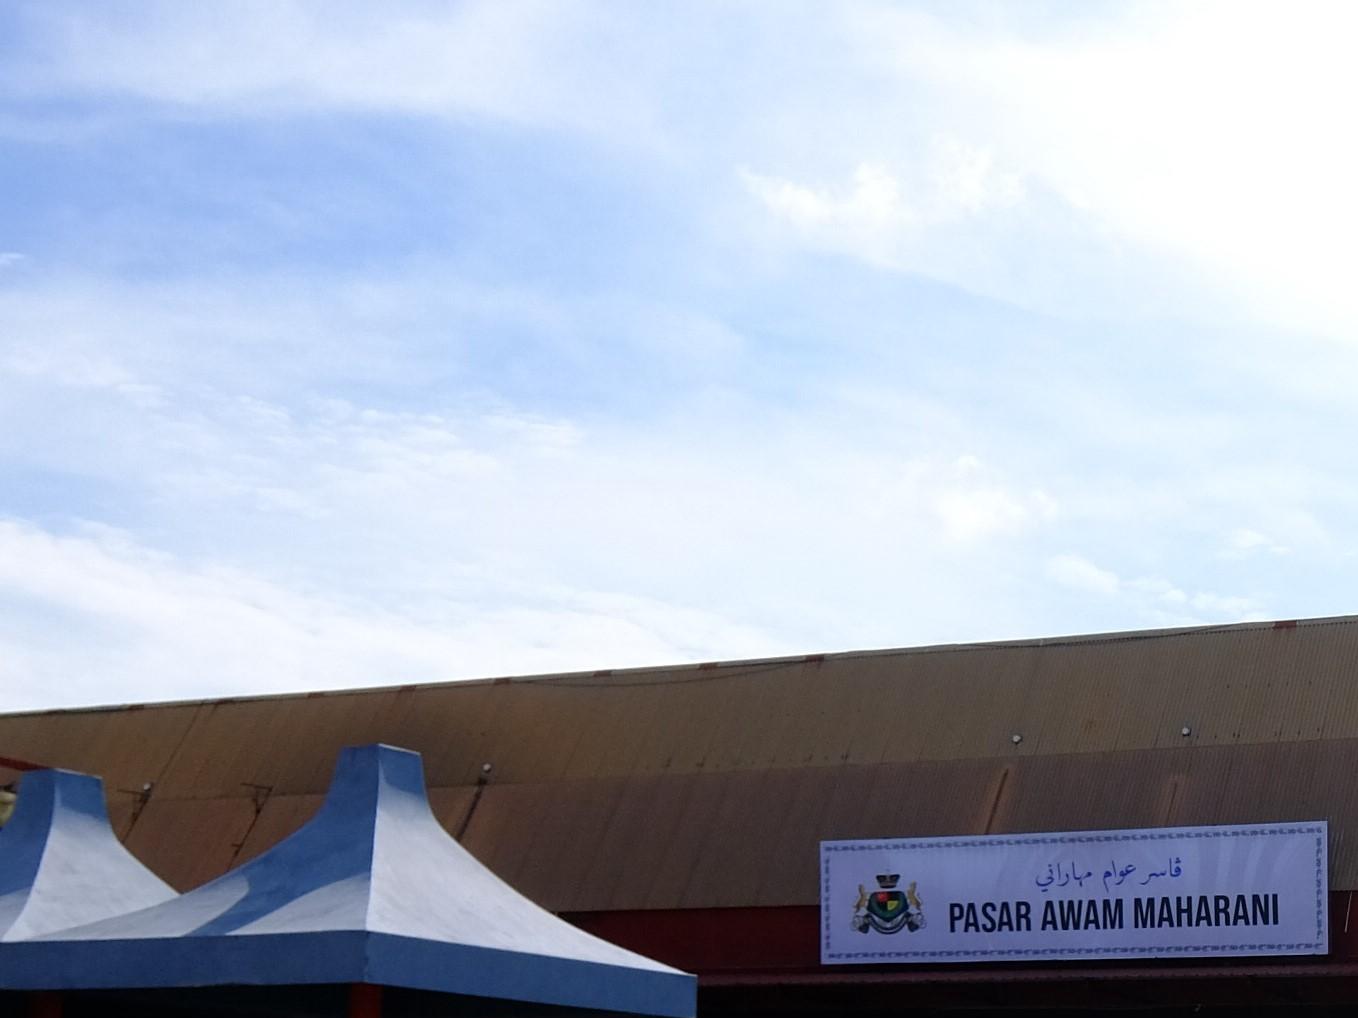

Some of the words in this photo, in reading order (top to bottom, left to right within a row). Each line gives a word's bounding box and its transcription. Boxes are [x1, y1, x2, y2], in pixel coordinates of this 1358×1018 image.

[1035, 861, 1093, 893] مهاراني
[1103, 860, 1137, 893] عوام
[950, 901, 1032, 933] PASAR
[1041, 899, 1124, 931] AWAM
[1134, 894, 1279, 928] MAHARANI
